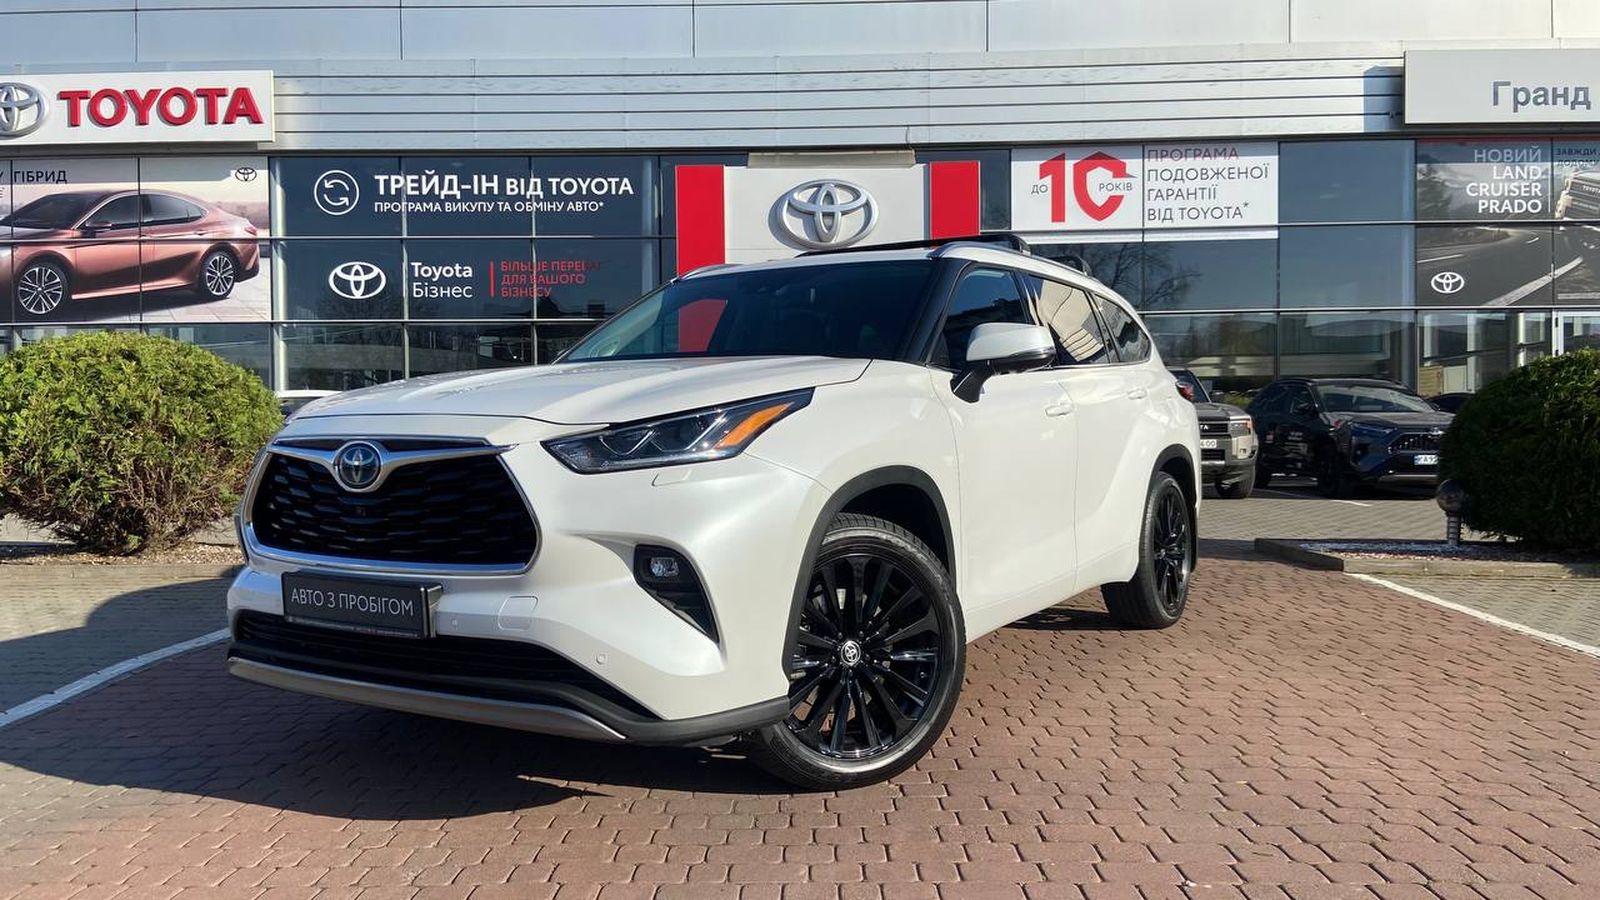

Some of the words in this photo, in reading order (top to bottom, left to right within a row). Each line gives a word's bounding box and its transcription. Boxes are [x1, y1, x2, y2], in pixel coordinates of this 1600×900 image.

[1492, 81, 1591, 113] Гранд
[57, 87, 264, 127] TOYOTA
[1147, 147, 1239, 163] ПРОГРАМА
[1474, 144, 1542, 162] НОВИЙ
[13, 170, 68, 185] ГІБРИД
[1147, 163, 1271, 183] ПОДОВЖЕНОЇ
[1492, 166, 1542, 180] LAND
[373, 169, 499, 200] ТРЕЙД-ІН
[505, 178, 544, 199] ВІД
[547, 177, 634, 196] TOYOTA
[1031, 184, 1049, 195] ДО
[1098, 181, 1133, 193] РОКІВ
[1465, 182, 1543, 197] CRUISER
[1147, 185, 1218, 202] ГАРАНТІЇ
[374, 202, 442, 213] ПРОГРАМА
[444, 201, 495, 213] ВИКУПУ
[498, 201, 512, 212] ТА
[514, 201, 565, 212] ОБМІНУ
[1478, 199, 1542, 213] PRADO
[1147, 207, 1174, 223] ВІД
[411, 262, 473, 281] Toyota
[501, 274, 527, 285] ДЛЯ
[412, 282, 473, 298] Бізнес
[501, 287, 552, 298] БІЗНЕСУ
[291, 588, 324, 606] АВТО
[339, 593, 414, 617] ПРОБІГОМ
